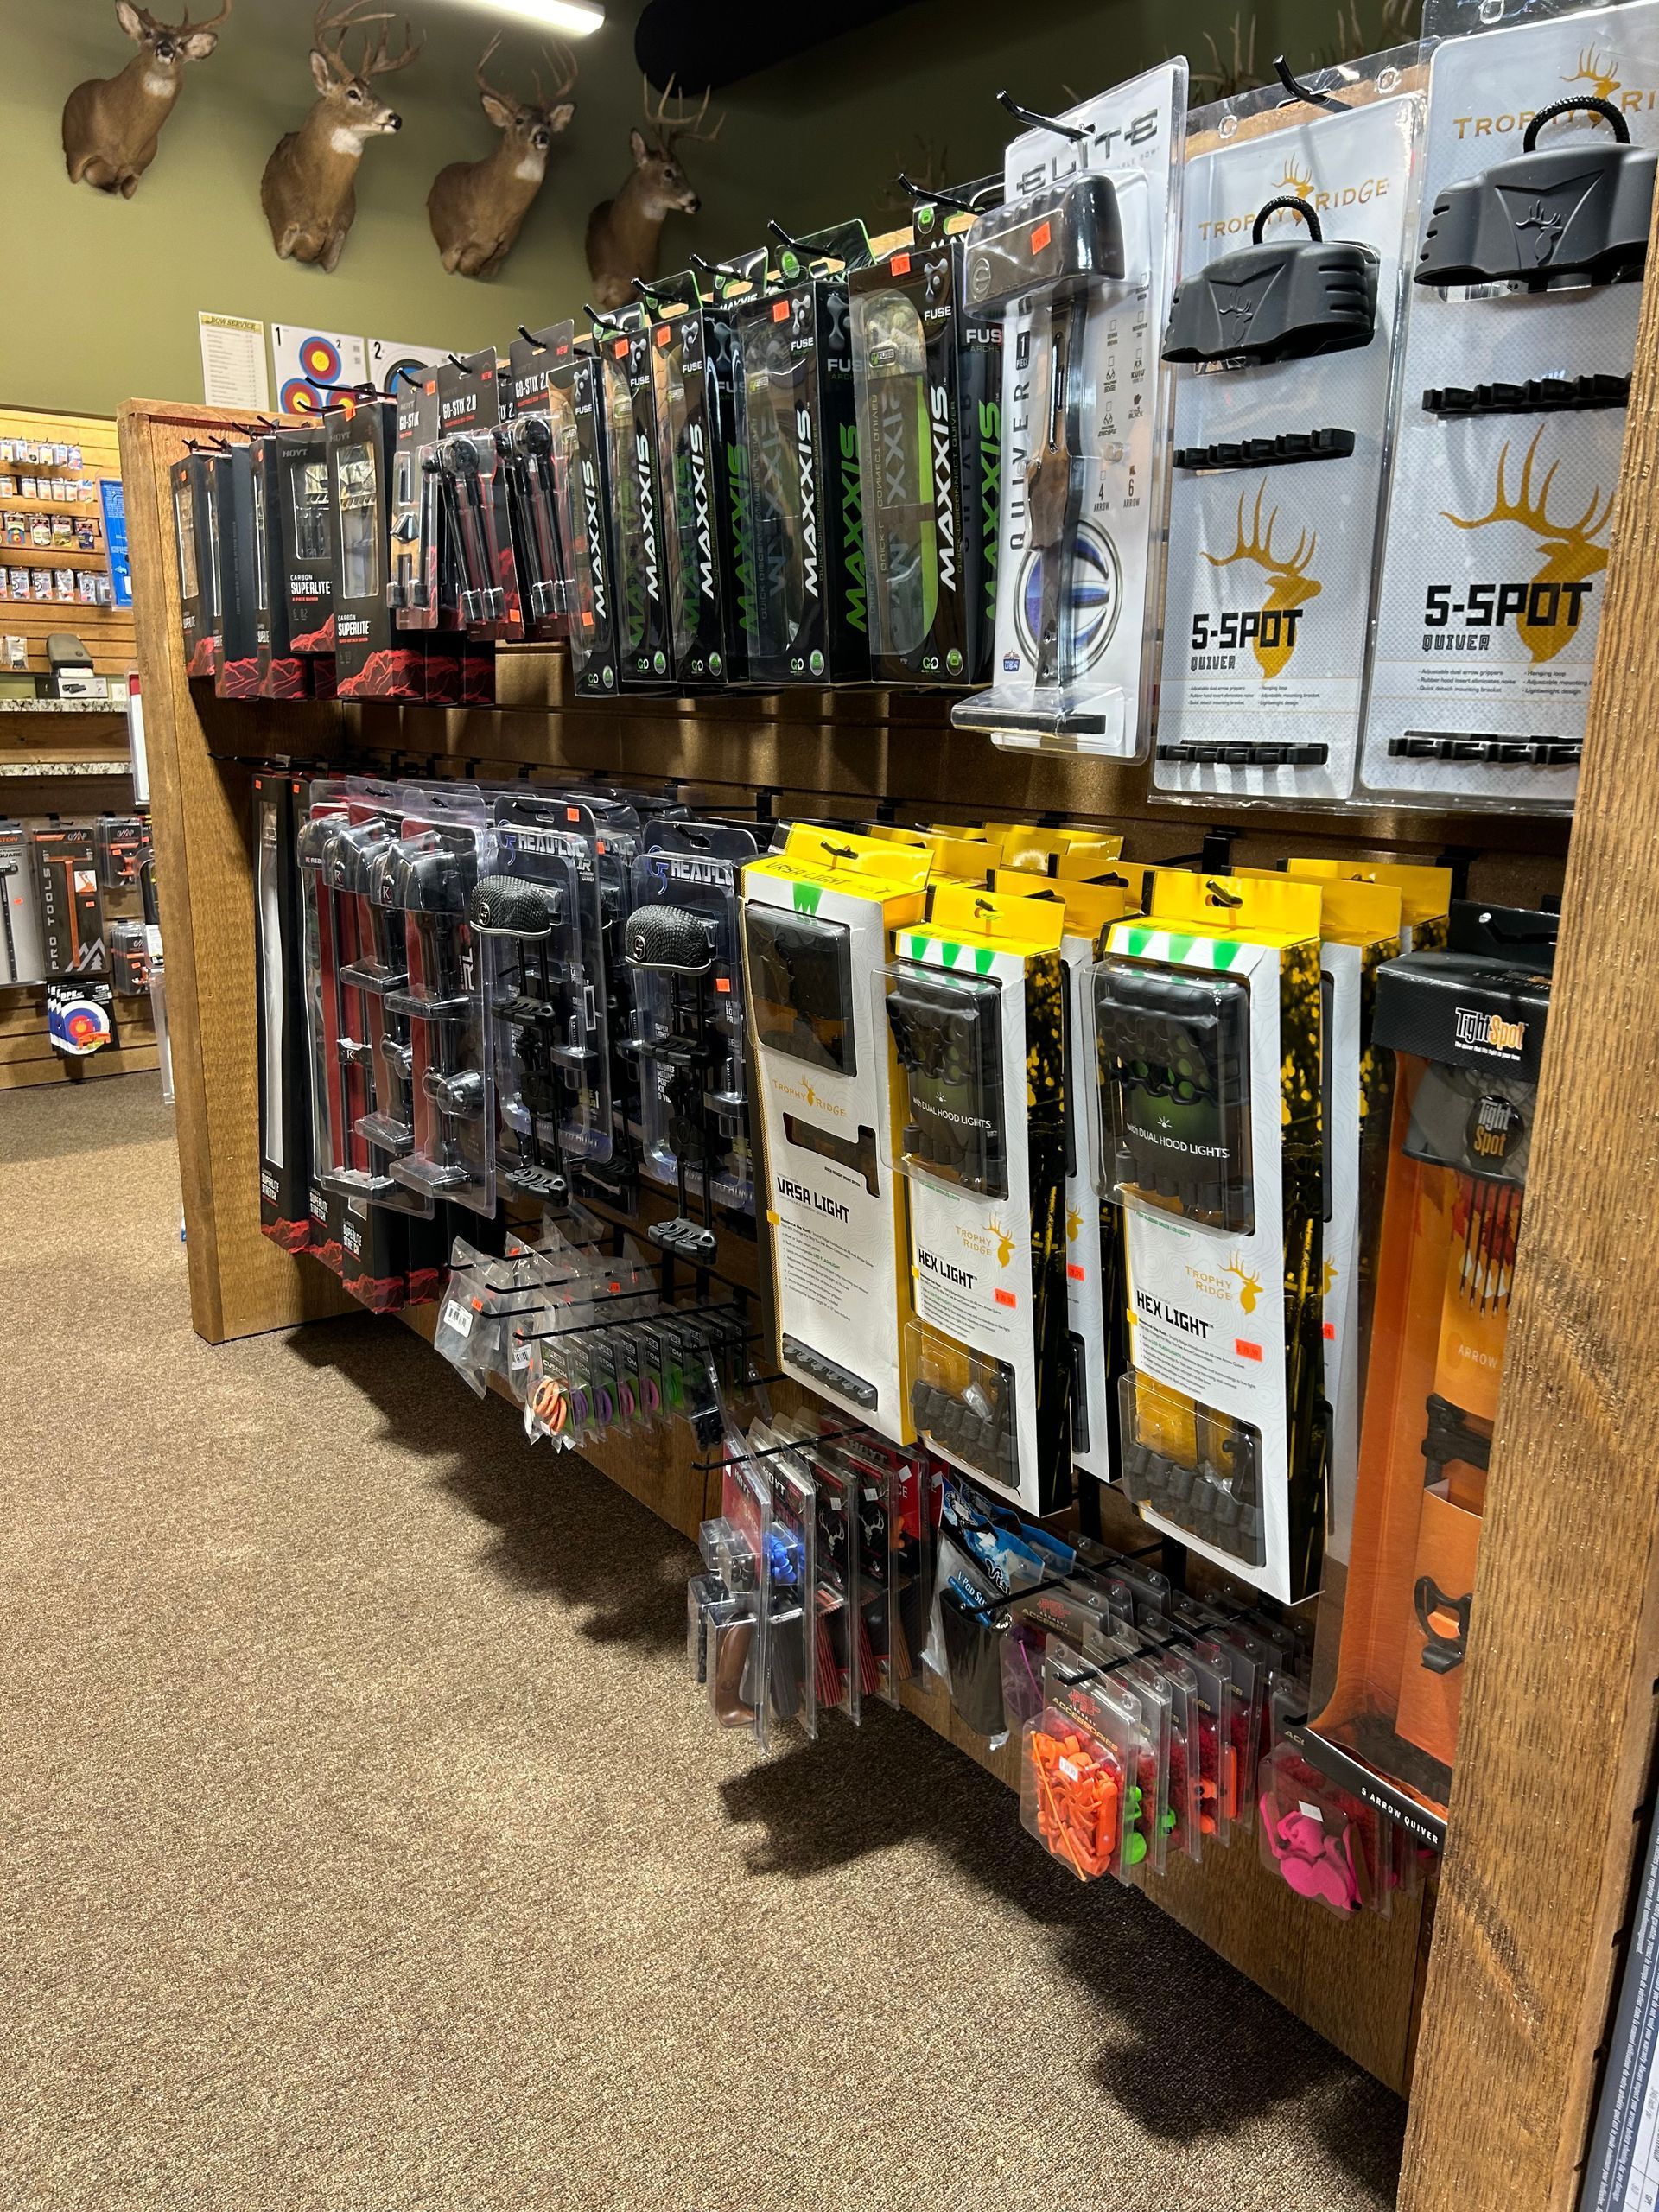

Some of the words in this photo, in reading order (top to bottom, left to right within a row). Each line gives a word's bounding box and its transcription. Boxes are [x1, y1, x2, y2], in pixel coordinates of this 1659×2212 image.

[1452, 110, 1575, 139] TROP
[1017, 108, 1158, 195] ELITE
[1198, 209, 1286, 241] TROPY
[1314, 178, 1389, 213] RIDGE
[924, 305, 952, 322] FUSE
[276, 327, 281, 346] 1
[335, 339, 341, 349] 2
[791, 337, 814, 351] FUSE
[967, 329, 1003, 344] FUS
[1020, 335, 1027, 352] 1
[373, 341, 382, 360] 2
[556, 344, 569, 356] NEW
[970, 345, 1003, 353] ARCHE
[683, 359, 703, 374] FUSE
[827, 358, 865, 373] FUS
[1016, 355, 1029, 368] PIECE
[480, 370, 493, 381] NEW
[516, 374, 539, 399] GO-STIX
[630, 375, 651, 388] FUSE
[442, 398, 466, 420] GO-STIX
[467, 394, 477, 412] 2.0
[575, 404, 594, 416] FUSE
[399, 411, 420, 431] GO-STIX
[283, 448, 308, 458] HOYT
[1010, 380, 1030, 551] QUIVER
[931, 385, 957, 593] MAXXIS
[1097, 482, 1105, 501] 4
[1127, 478, 1135, 498] 6
[690, 424, 714, 601] MAXXIS
[797, 408, 819, 599] MAXXIS
[1093, 500, 1111, 512] ARROW
[1123, 496, 1141, 509] ARROW
[636, 434, 659, 602] MAXXIS
[582, 460, 607, 620] MAXXIS
[290, 581, 332, 595] SUPERLITE
[1425, 582, 1593, 627] 5-SPOT
[337, 620, 371, 637] SUPERLITE
[1192, 609, 1304, 650] 5-SPOT
[1422, 634, 1490, 652] QUIVER
[1190, 655, 1236, 671] QUIVER
[43, 867, 56, 925] TOOLS
[48, 934, 60, 971] PRO
[1454, 1007, 1526, 1051] TightSpot
[772, 1078, 807, 1101] TROPHY
[815, 1097, 847, 1117] RIDGE
[922, 1101, 938, 1116] DUAL
[938, 1109, 960, 1123] HOOD
[960, 1116, 992, 1130] LIGHTS
[1478, 1098, 1512, 1131] Tight
[1125, 1122, 1139, 1135] with
[1138, 1127, 1160, 1145] DUAL
[1159, 1135, 1188, 1153] HOOD
[1189, 1142, 1230, 1160] LIGHTS
[1473, 1124, 1507, 1157] Spot
[813, 1191, 850, 1224] LIGHT
[954, 1224, 993, 1246] TROPHY
[962, 1237, 993, 1256] RIDGE
[918, 1249, 938, 1276] HEX
[939, 1260, 974, 1291] LIGHT
[1185, 1264, 1232, 1290] TROPHY
[1194, 1280, 1233, 1301] RIDGE
[1136, 1289, 1163, 1320] HEX
[1165, 1304, 1210, 1339] LIGHT
[1457, 1344, 1498, 1370] ARROW
[543, 1359, 568, 1380] CUSTOM
[762, 1465, 787, 1497] HOYT
[1052, 1695, 1120, 1752] ACCESSORIES
[1361, 1785, 1368, 1796] 5
[1370, 1792, 1402, 1820] ARROW
[1403, 1815, 1439, 1846] QUIVER
